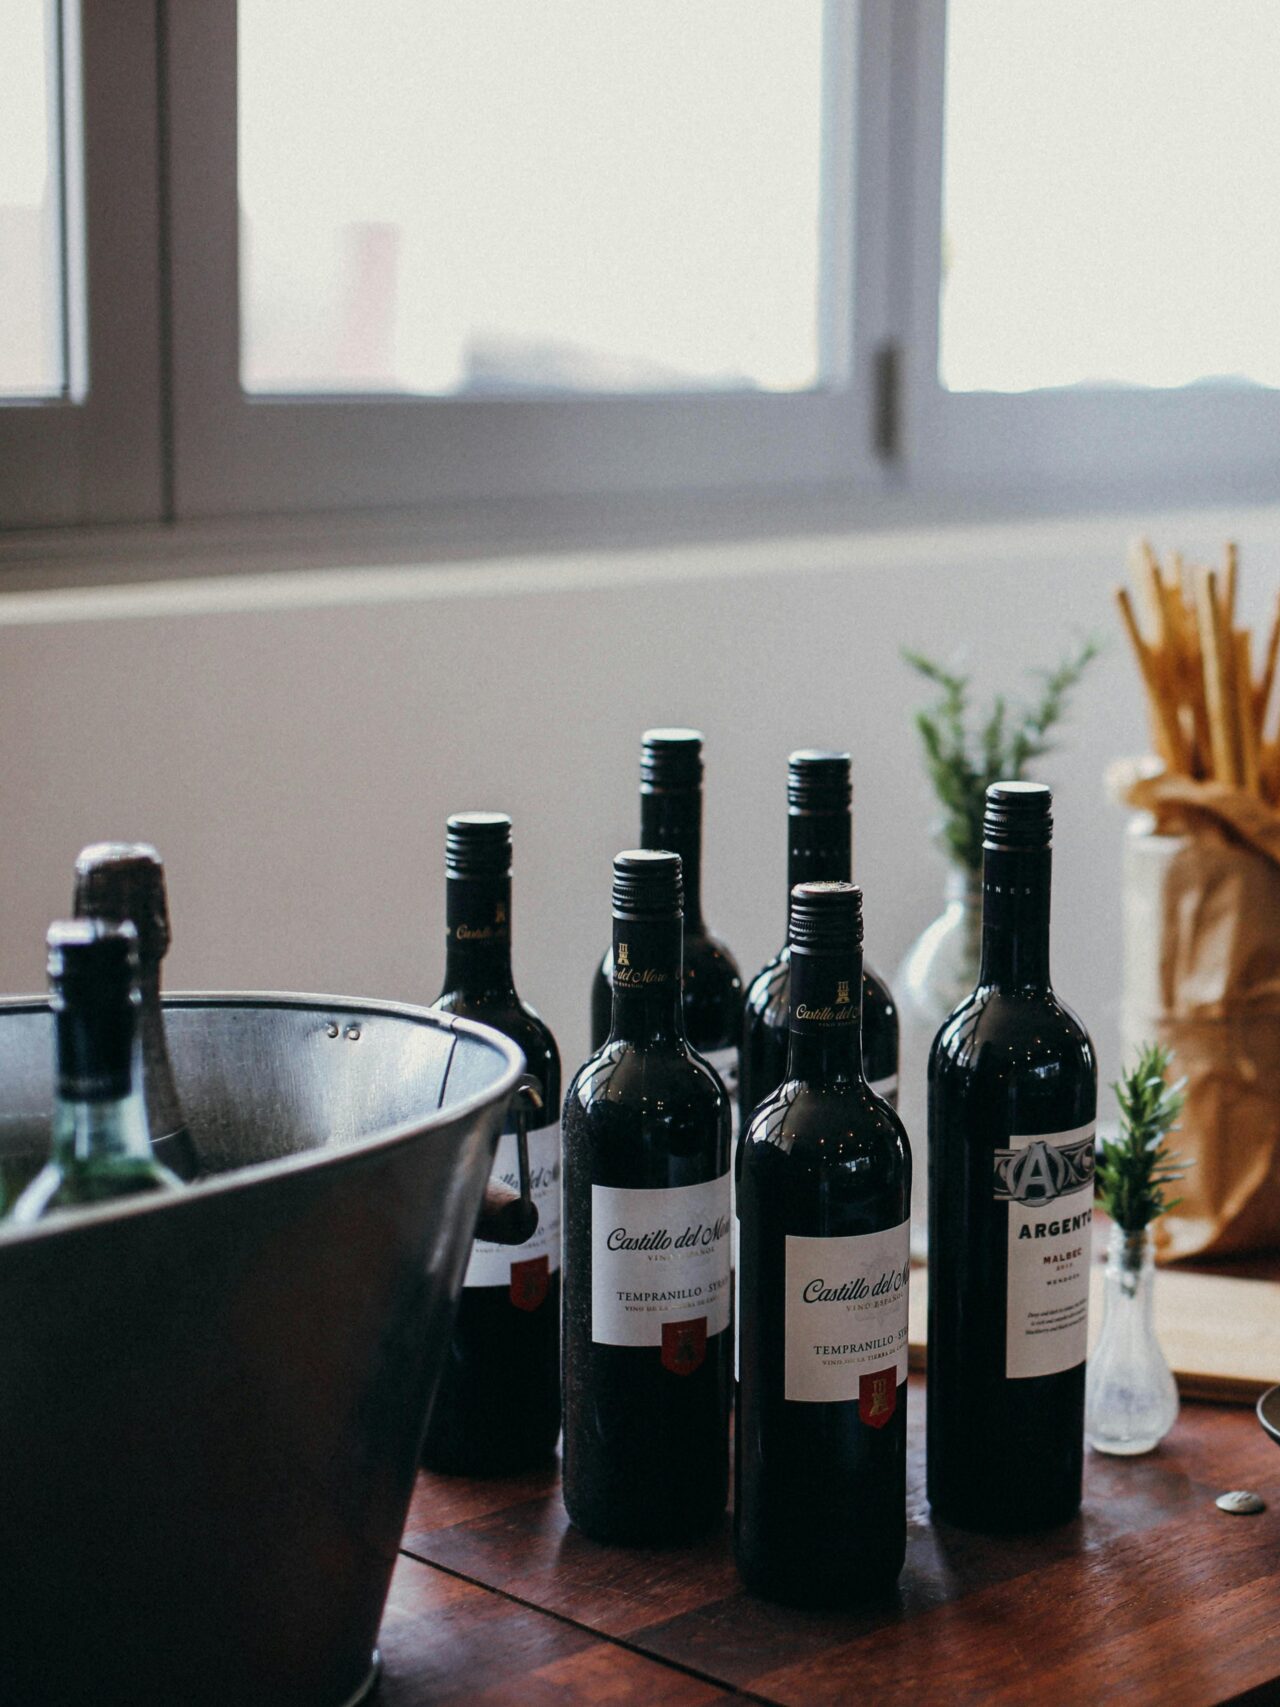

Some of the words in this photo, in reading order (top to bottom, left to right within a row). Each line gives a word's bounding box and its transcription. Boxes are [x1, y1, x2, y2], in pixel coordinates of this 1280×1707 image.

[796, 1003, 834, 1020] Castillo
[1018, 1208, 1092, 1239] ARGENTO
[607, 1228, 672, 1251] Castillo
[674, 1224, 702, 1249] del
[1043, 1248, 1083, 1264] MALBEC
[616, 1287, 702, 1301] TEMPRANILLO
[803, 1278, 870, 1304] Castillo
[871, 1269, 895, 1297] del
[846, 1303, 871, 1313] VINO
[813, 1335, 894, 1355] TEMPRANILLO
